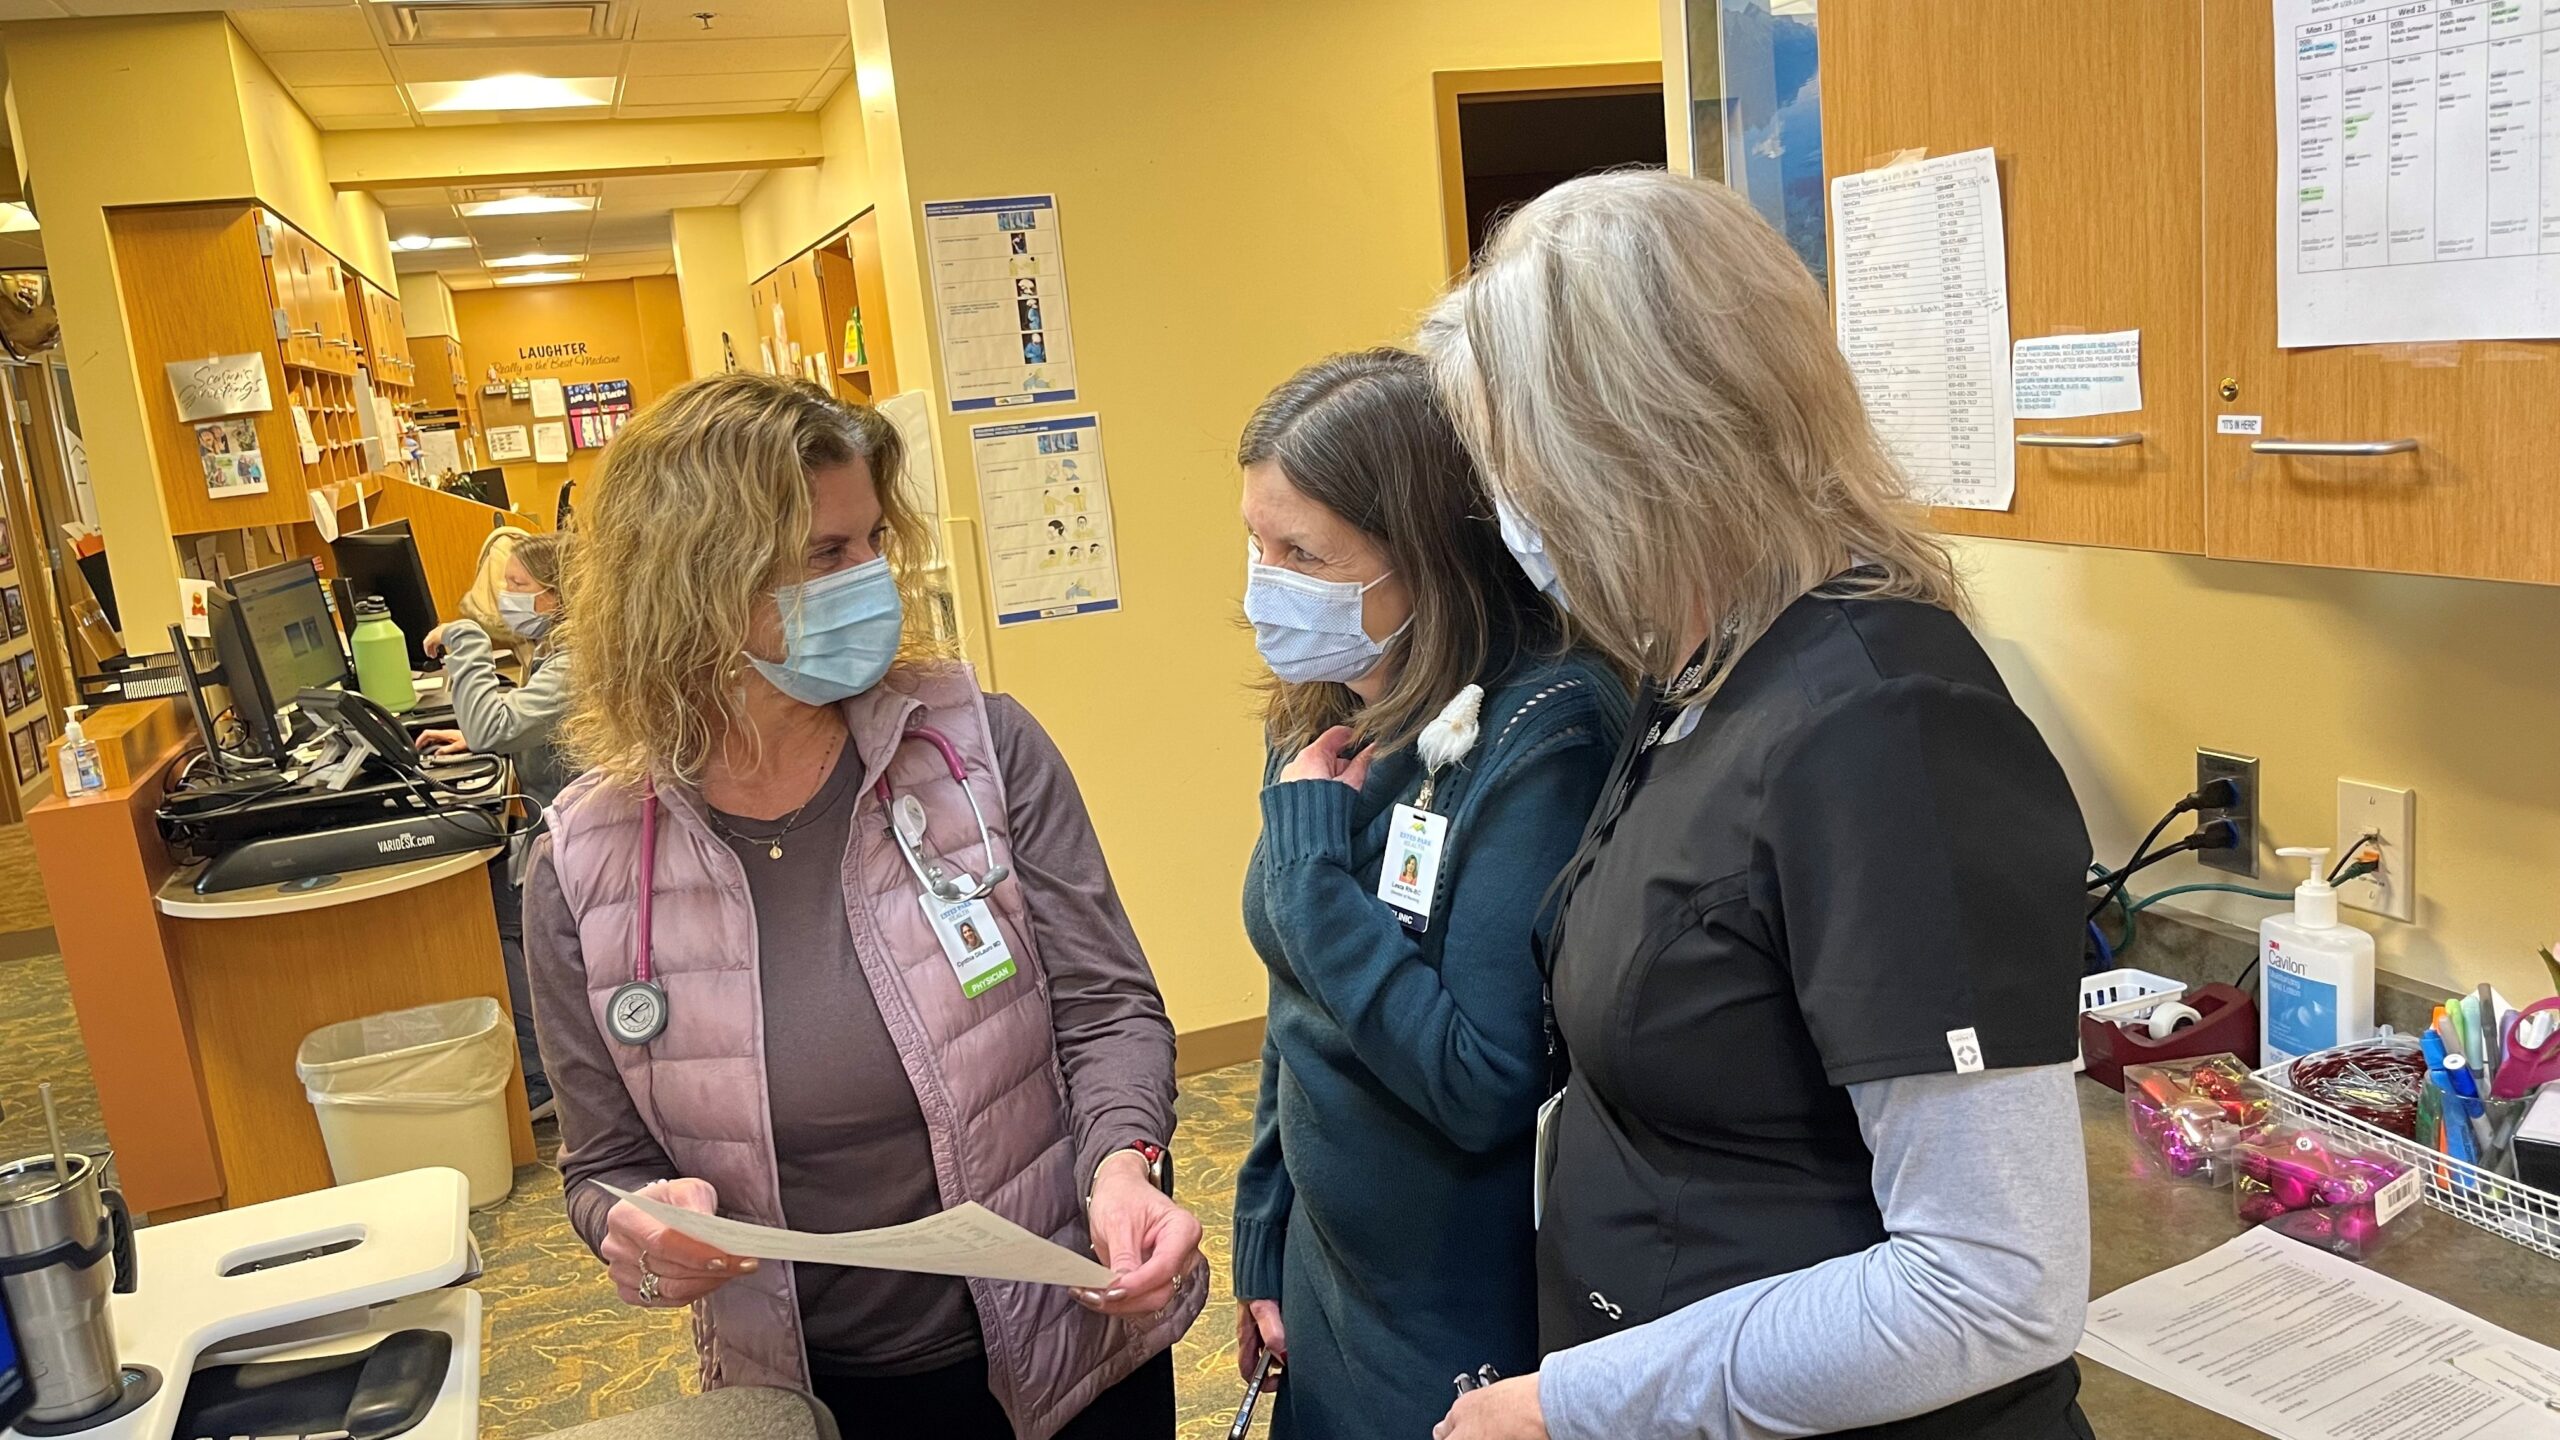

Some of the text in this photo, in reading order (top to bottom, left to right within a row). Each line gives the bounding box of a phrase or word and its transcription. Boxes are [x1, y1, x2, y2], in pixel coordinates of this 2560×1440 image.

[2367, 14, 2376, 22] 24
[2398, 4, 2426, 16] Wed 25
[2324, 23, 2333, 31] 23
[519, 342, 587, 359] LAUGHTER
[492, 361, 522, 375] Really
[535, 361, 548, 370] the
[548, 357, 573, 369] Best
[574, 354, 620, 366] Medicine
[377, 833, 435, 854] VARIDESK.com
[2269, 940, 2279, 950] 3M
[2269, 950, 2305, 976] Cavilon
[972, 967, 1009, 992] PHYSICIAN
